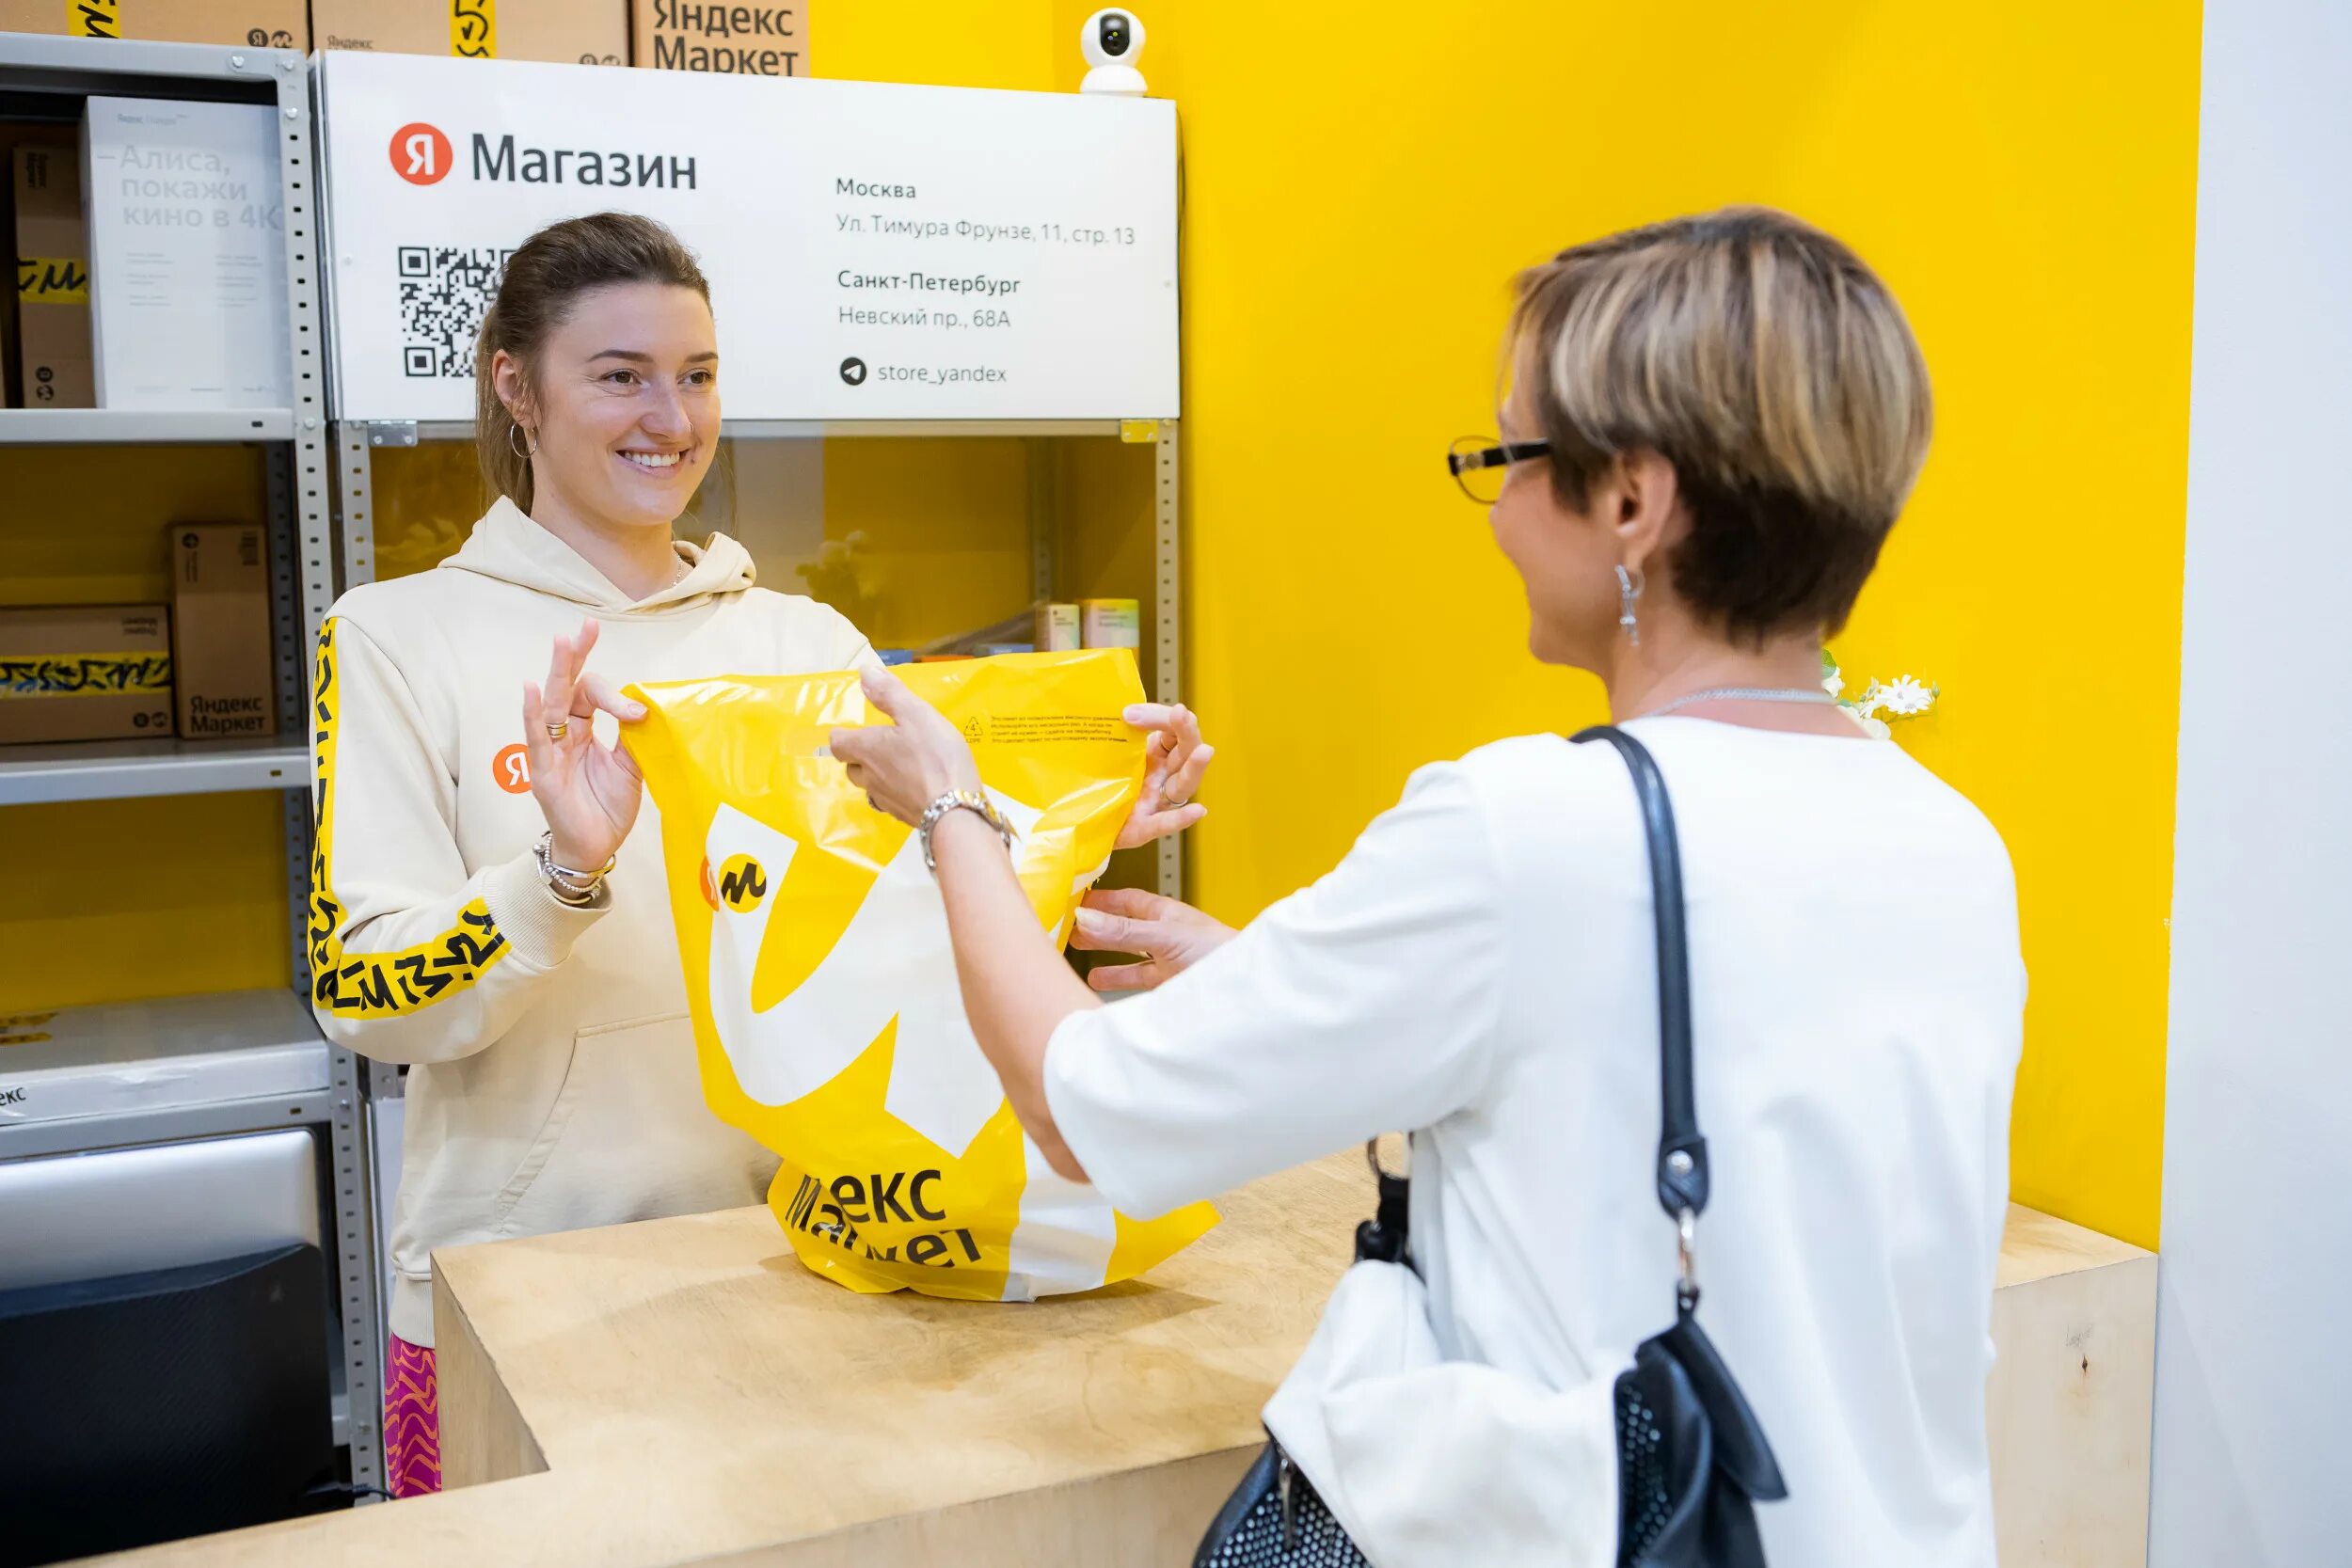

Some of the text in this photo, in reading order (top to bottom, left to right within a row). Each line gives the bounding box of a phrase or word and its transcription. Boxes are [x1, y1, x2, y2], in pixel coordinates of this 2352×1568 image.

[653, 0, 794, 39] Яндекс
[653, 35, 800, 77] Маркет
[119, 144, 231, 177] Алиса,
[471, 132, 697, 190] Магазин
[121, 177, 248, 201] покажи
[836, 178, 916, 199] Москва
[123, 206, 203, 228] кино
[213, 211, 230, 228] в
[836, 214, 1136, 246] Ул. Тимура Фрунзе, 11, стр. 13
[837, 270, 1021, 296] Санкт-Петербург
[839, 306, 1011, 330] Невский пр., 68А
[878, 365, 1008, 386] store_yandex
[191, 695, 262, 715] Яндекс
[191, 715, 265, 734] Маркет
[785, 1174, 981, 1268] Мает
